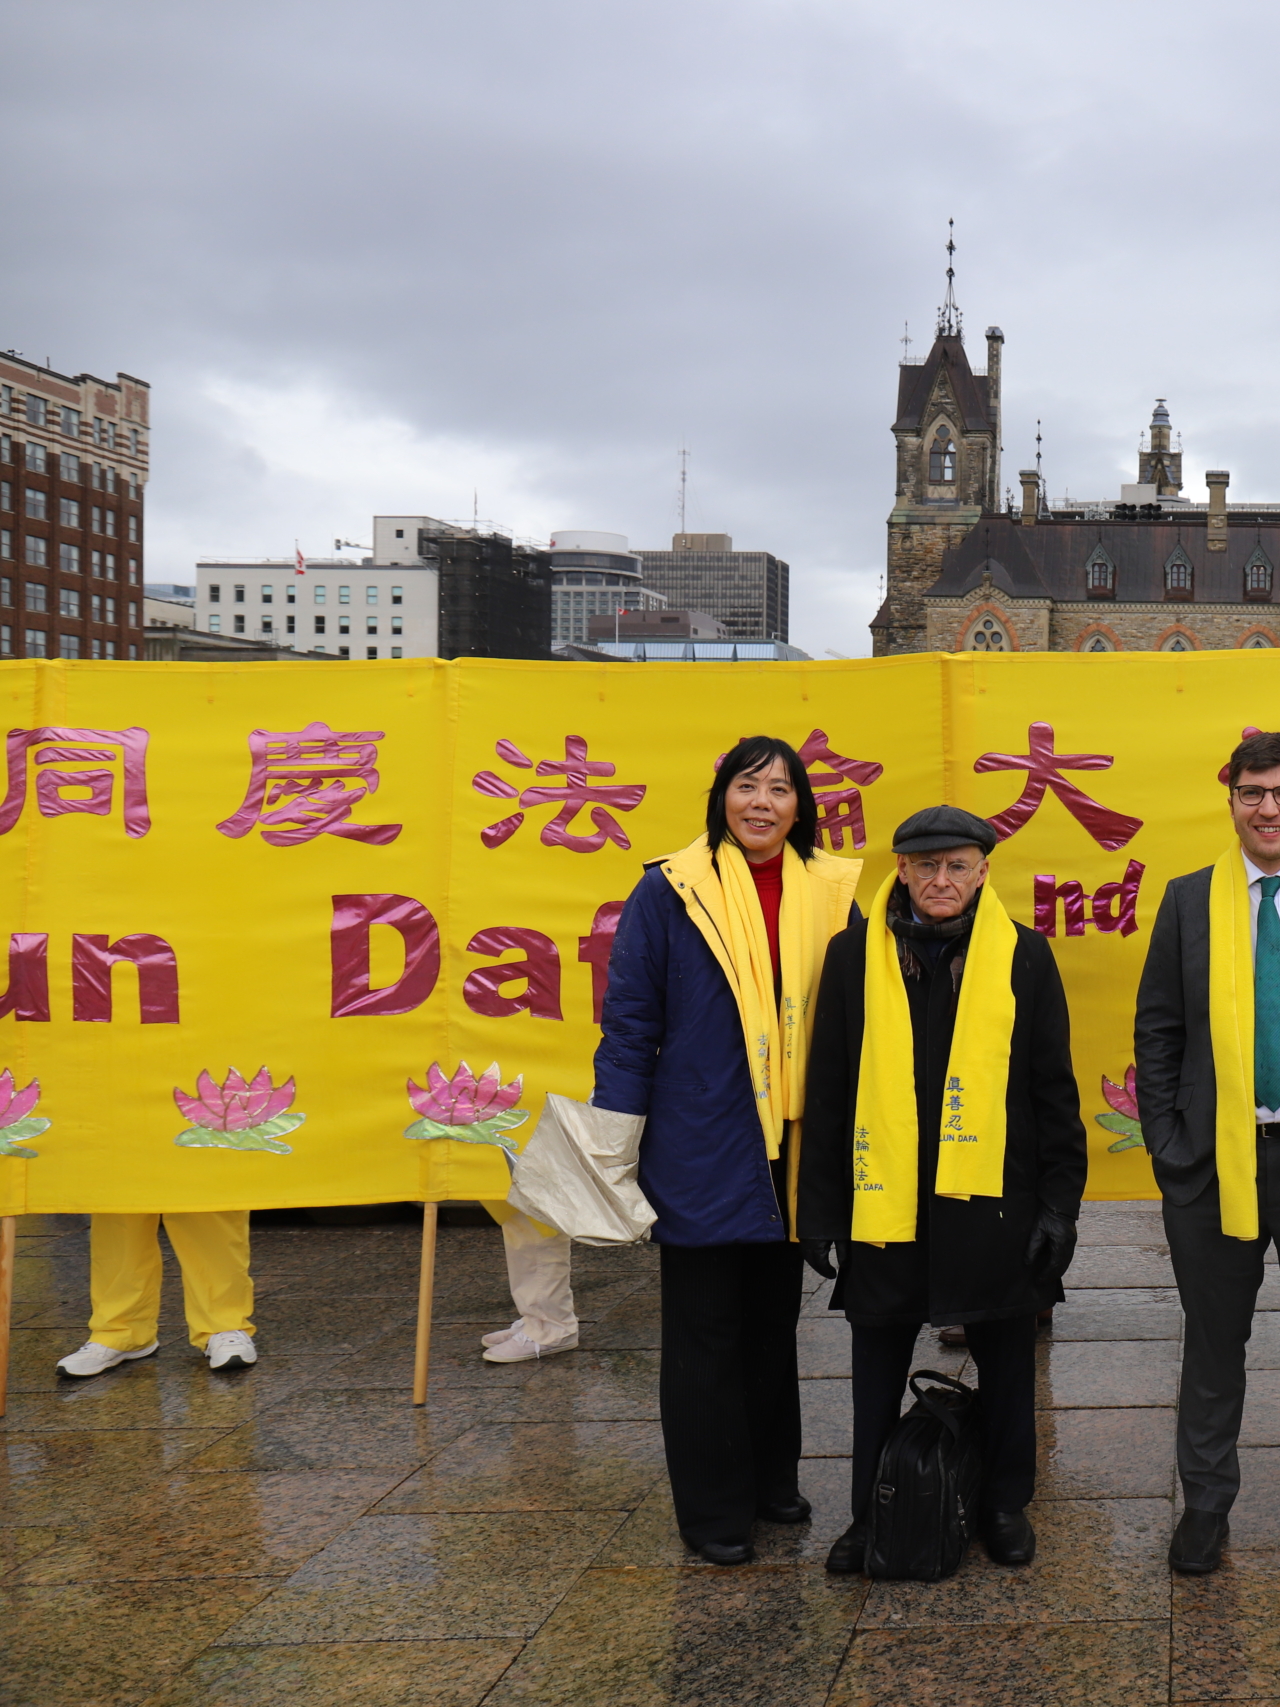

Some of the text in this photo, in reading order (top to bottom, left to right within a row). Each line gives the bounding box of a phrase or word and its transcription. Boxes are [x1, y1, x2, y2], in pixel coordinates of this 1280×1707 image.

[957, 1134, 978, 1142] DAFA
[854, 1125, 870, 1181] 法輪大法
[863, 1183, 884, 1191] DAFA
